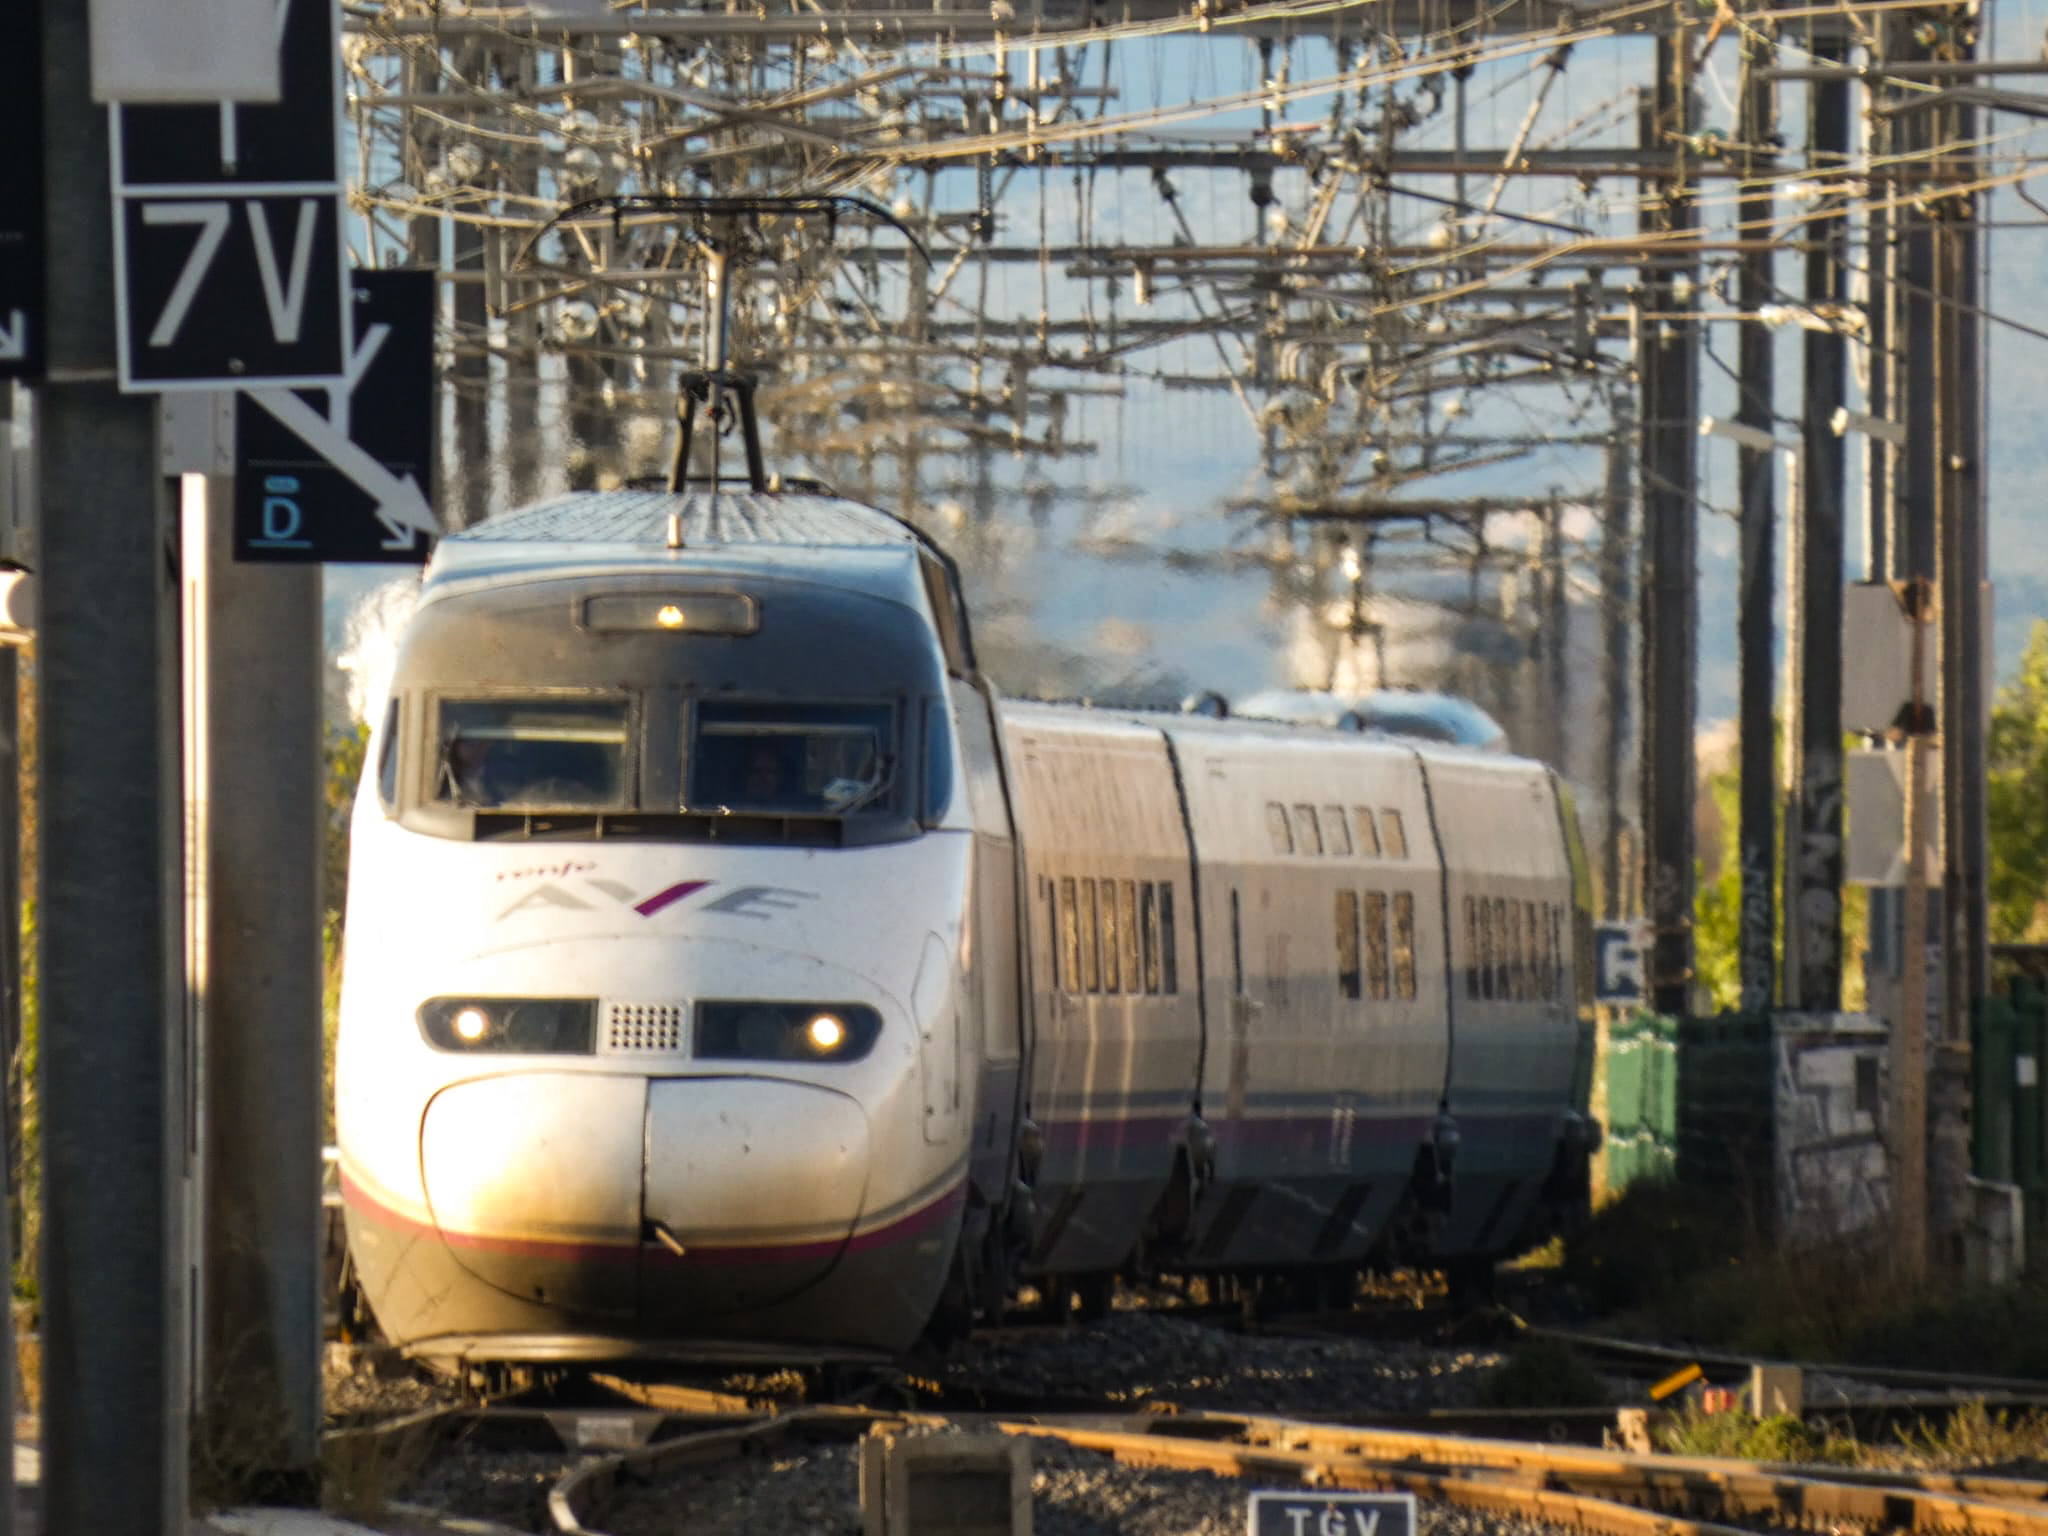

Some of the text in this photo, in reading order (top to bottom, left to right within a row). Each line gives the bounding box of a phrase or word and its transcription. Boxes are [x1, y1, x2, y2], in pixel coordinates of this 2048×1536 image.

[142, 201, 318, 347] 7V
[263, 497, 300, 540] D
[496, 878, 820, 920] AVE
[1285, 1507, 1380, 1536] TGV
